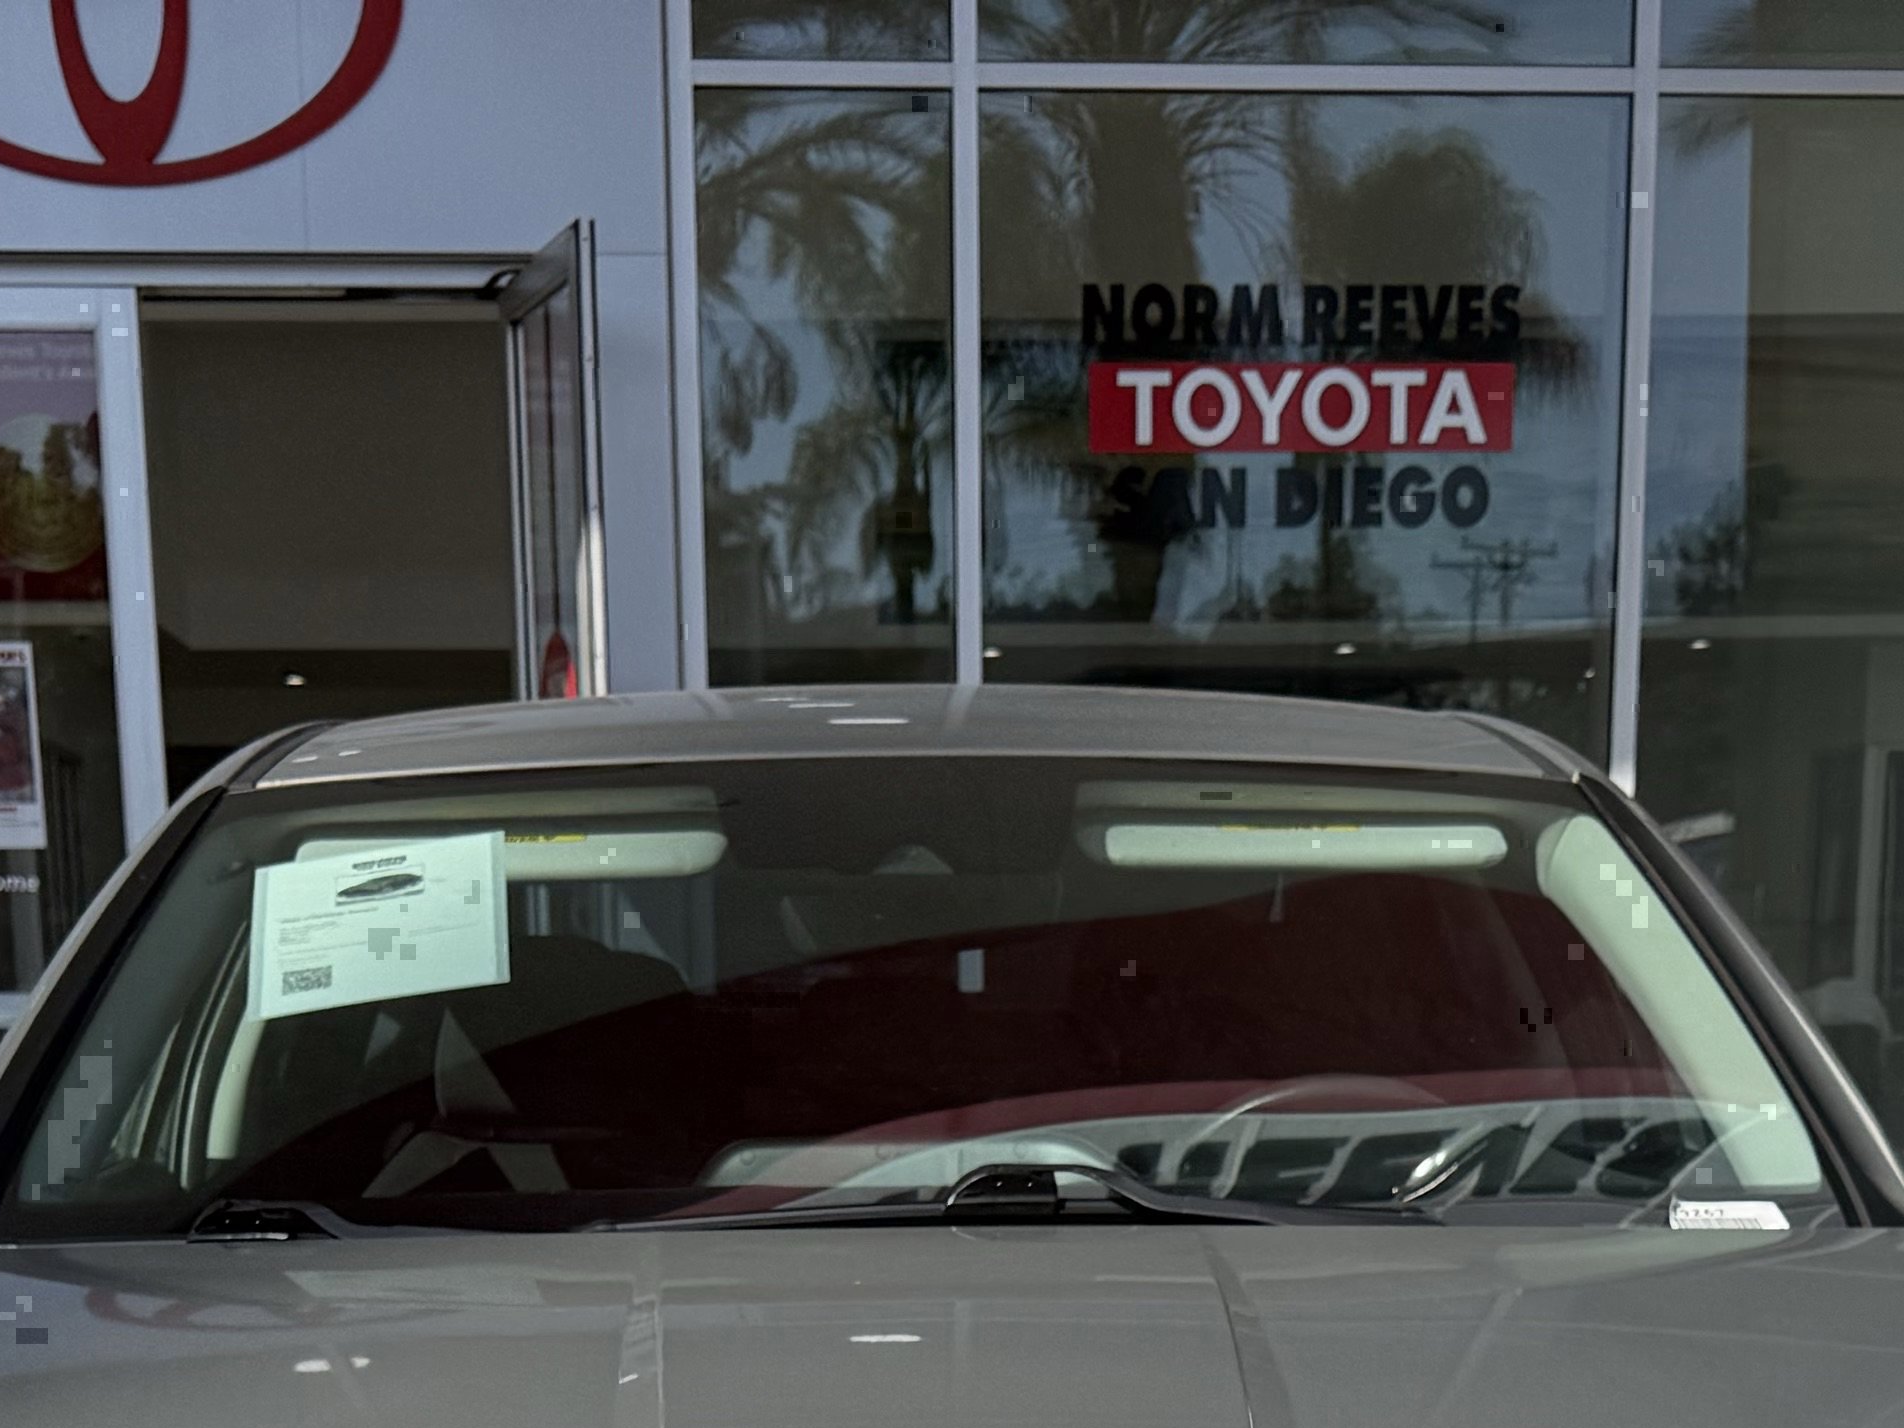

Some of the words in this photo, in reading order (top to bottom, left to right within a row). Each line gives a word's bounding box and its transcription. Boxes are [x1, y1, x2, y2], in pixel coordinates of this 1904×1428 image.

[1082, 283, 1284, 347] NORM
[1301, 284, 1522, 347] REEVES
[1116, 367, 1488, 448] TOYOTA
[1110, 466, 1247, 529] SAN
[1275, 465, 1491, 529] DIEGO
